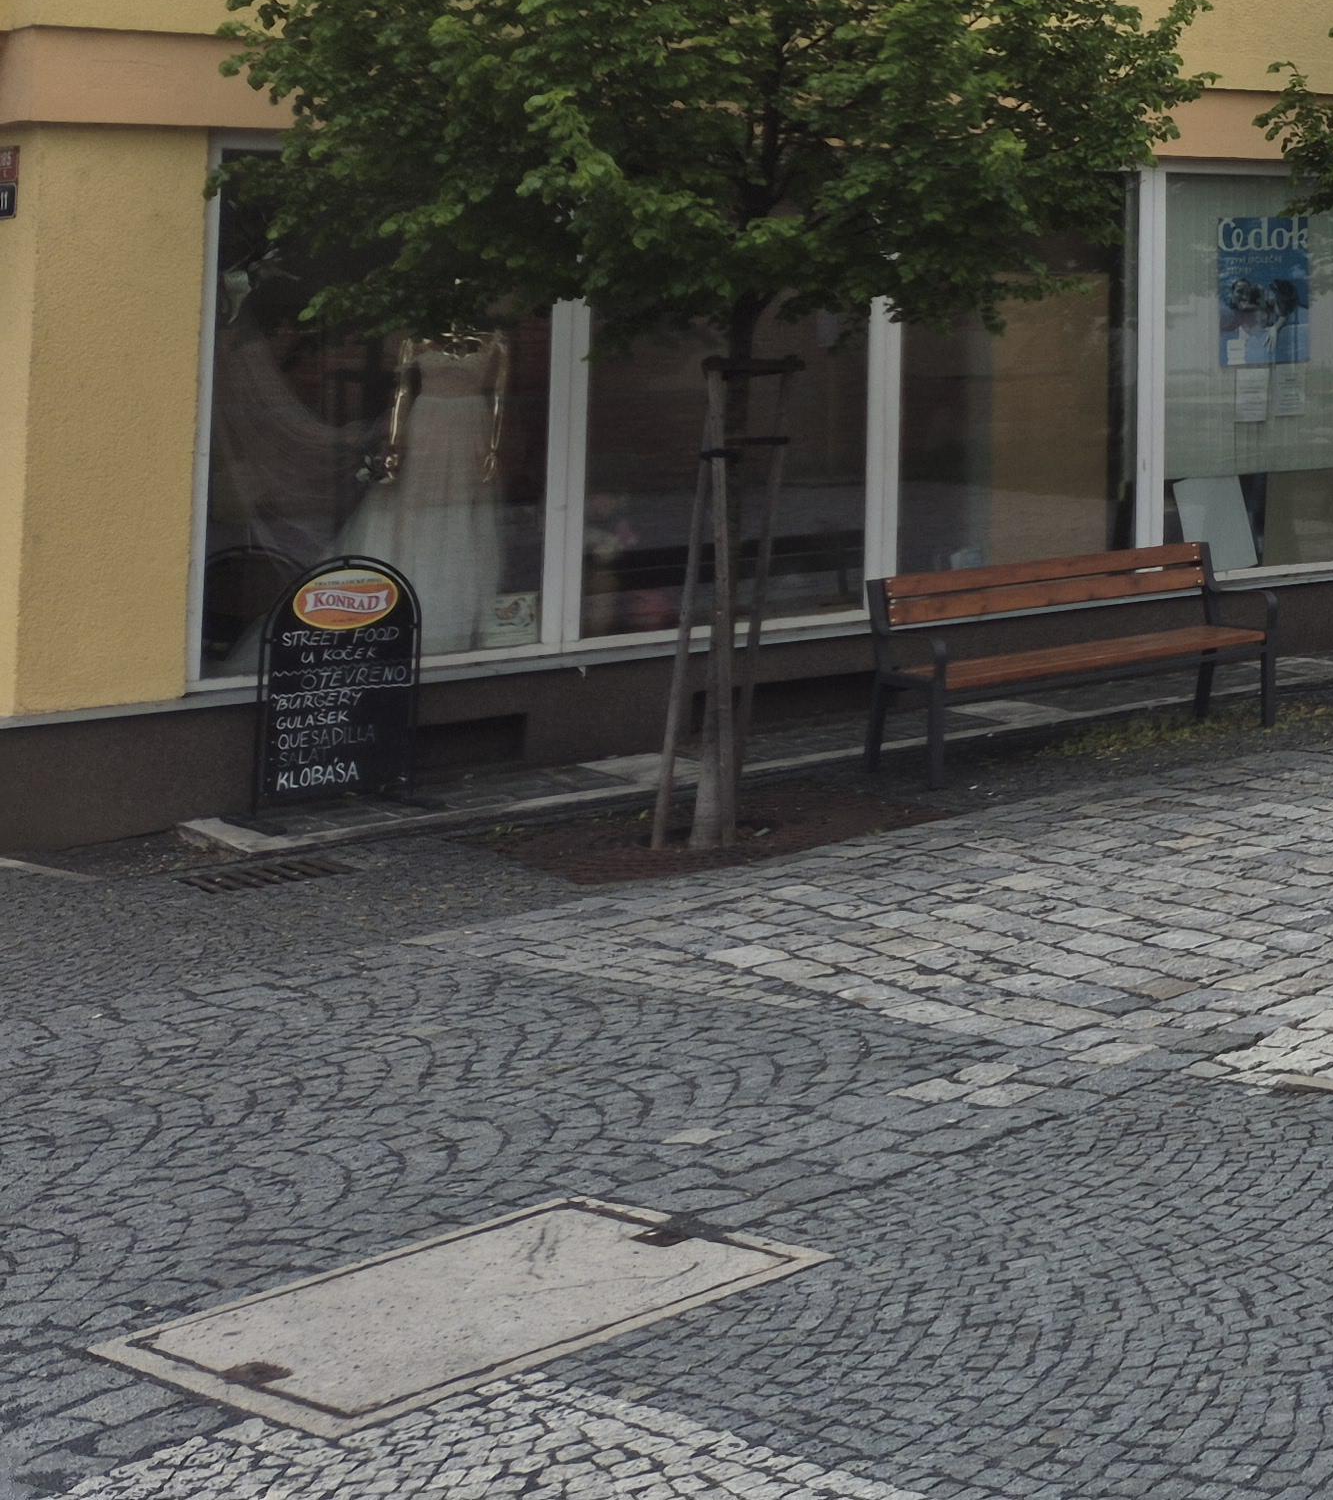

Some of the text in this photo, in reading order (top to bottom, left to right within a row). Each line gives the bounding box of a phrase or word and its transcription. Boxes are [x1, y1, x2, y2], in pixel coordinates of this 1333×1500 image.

[313, 592, 380, 610] KONRAD
[282, 627, 399, 647] STREET FOOD
[322, 646, 377, 661] KOČEK
[276, 691, 362, 711] BURGERY
[276, 708, 350, 730] GULÁŠEK
[277, 725, 376, 750] QUESADILLA
[276, 757, 360, 791] KLOBÁSA
